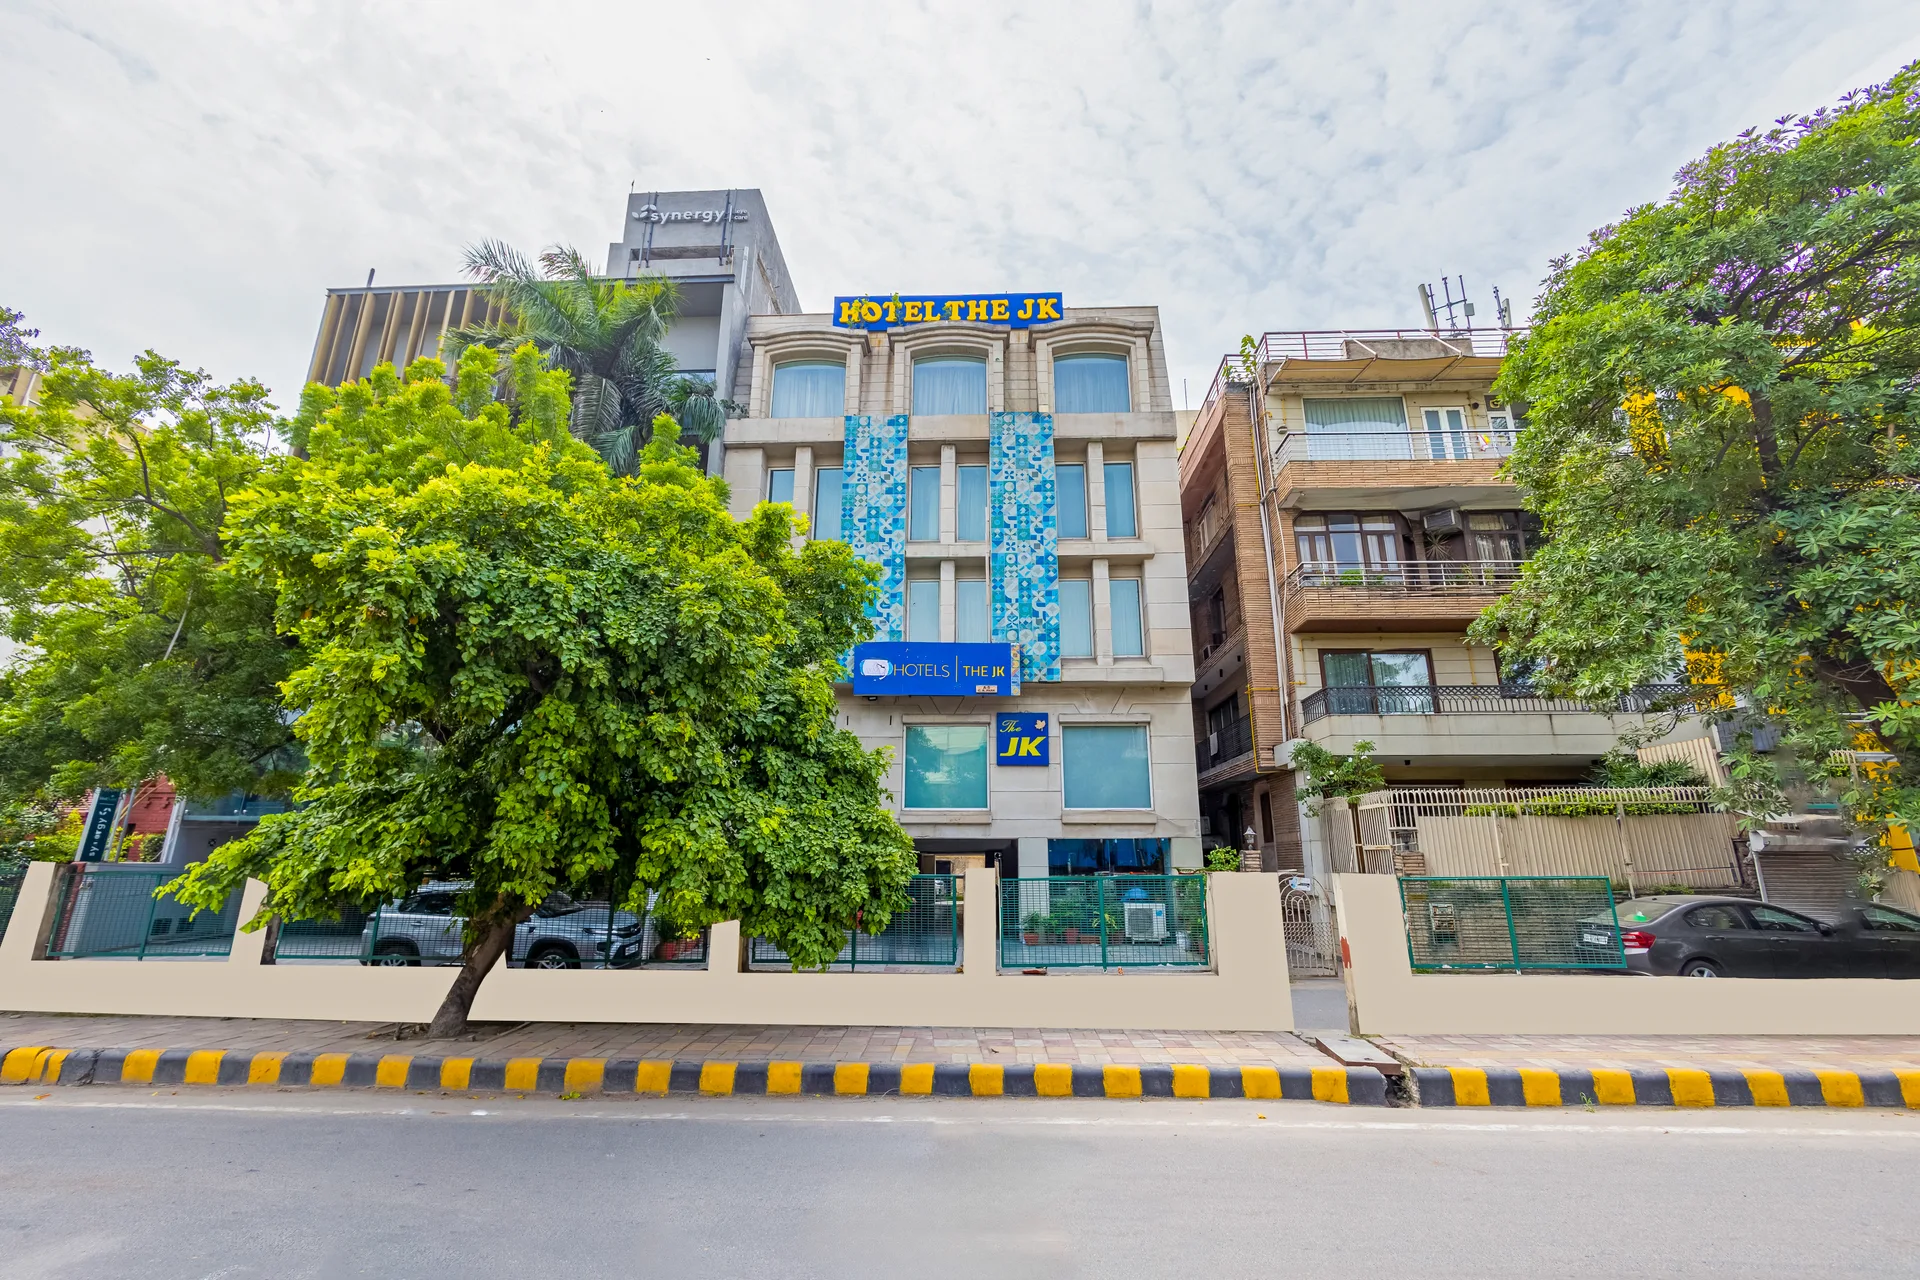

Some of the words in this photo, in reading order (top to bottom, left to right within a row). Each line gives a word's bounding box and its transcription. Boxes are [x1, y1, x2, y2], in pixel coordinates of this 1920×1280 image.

[650, 210, 724, 224] synergy
[839, 301, 940, 322] HOTEL
[944, 299, 1010, 321] THE
[1017, 298, 1060, 319] JK
[893, 663, 950, 678] HOTELS
[963, 665, 988, 677] THE
[991, 665, 1005, 678] JK
[1000, 719, 1022, 732] The
[1000, 736, 1046, 756] JK
